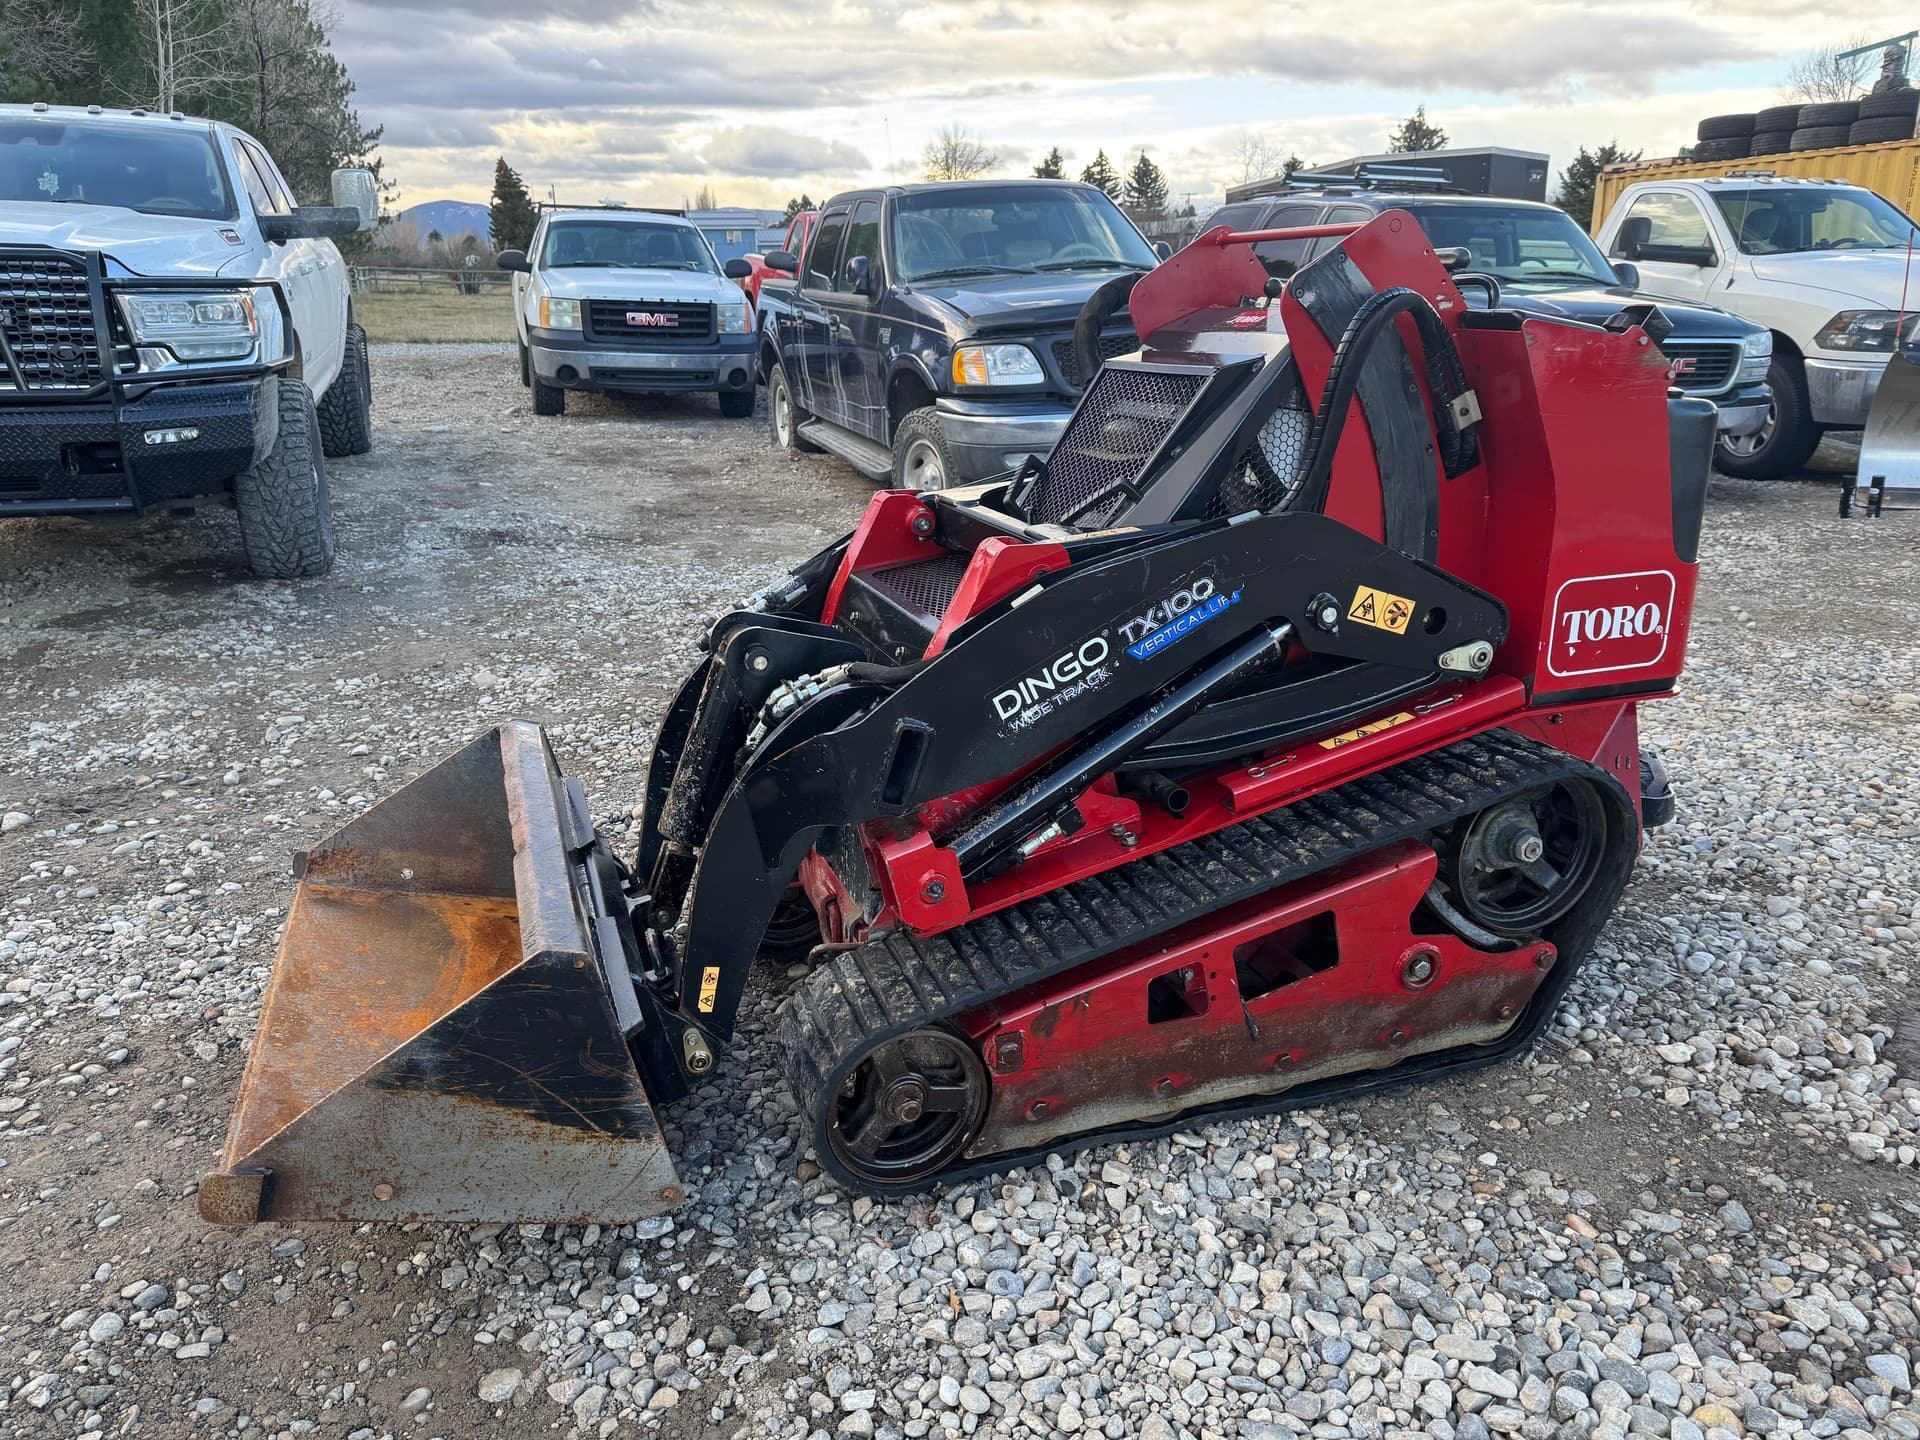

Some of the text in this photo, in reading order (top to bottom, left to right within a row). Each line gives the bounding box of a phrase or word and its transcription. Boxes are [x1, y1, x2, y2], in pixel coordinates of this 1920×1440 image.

[626, 312, 679, 327] GMC
[1671, 357, 1697, 373] MC
[1133, 610, 1208, 656] VERTICAL
[1562, 603, 1661, 644] TORO
[992, 637, 1109, 720] DINGO
[1008, 667, 1109, 732] WIDE TRACK
